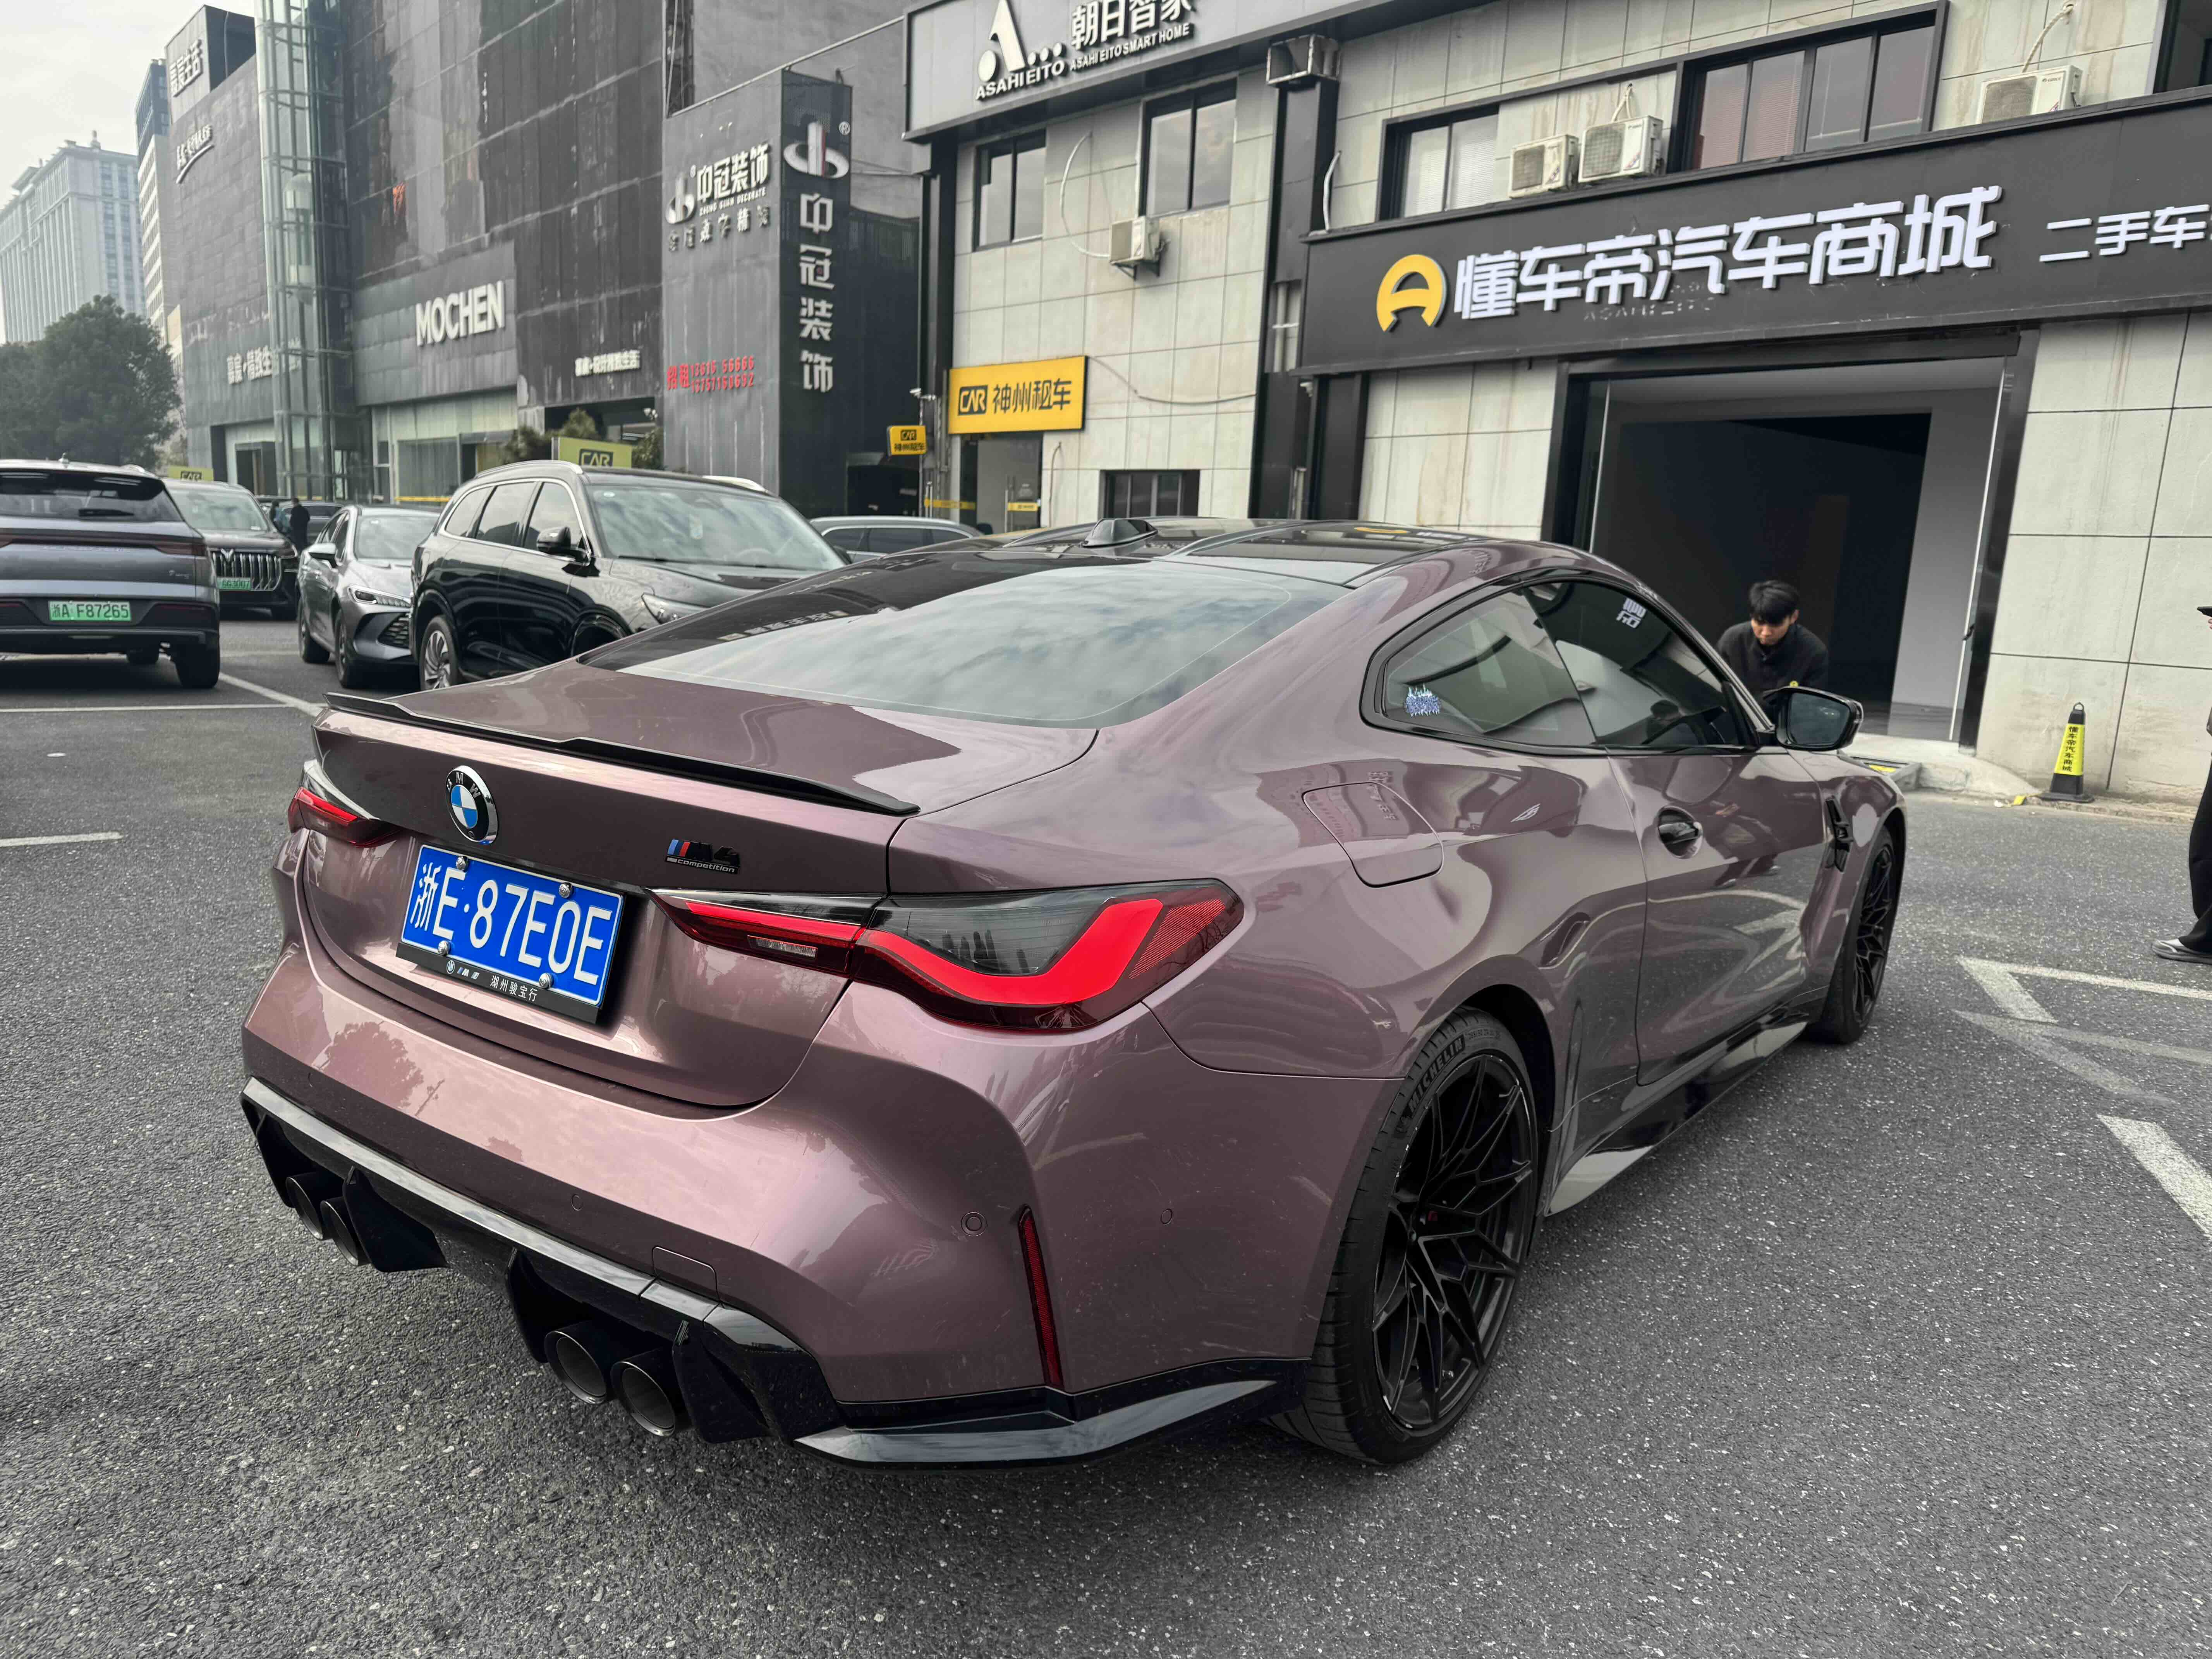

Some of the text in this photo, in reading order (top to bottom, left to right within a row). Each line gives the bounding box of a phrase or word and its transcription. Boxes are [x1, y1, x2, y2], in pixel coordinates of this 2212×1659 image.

[1070, 22, 1190, 71] ASAHI EITO SMART HOME
[975, 60, 1065, 100] ASAHI EITO
[697, 143, 768, 203] 中冠装饰
[1455, 186, 2002, 319] 懂车帝汽车商城
[2039, 204, 2212, 262] 二手车
[416, 280, 505, 346] MOCHEN
[799, 192, 835, 393] 中冠装饰
[666, 362, 690, 391] 招租
[960, 378, 1072, 414] CAR 神州租车
[582, 452, 610, 466] CAR
[2063, 726, 2078, 772] 懂车帝汽车商城
[447, 771, 481, 799] BMW
[678, 859, 735, 873] competition
[490, 975, 538, 1002] 湖州骏宝行
[1408, 1038, 1463, 1113] MICHELIN
